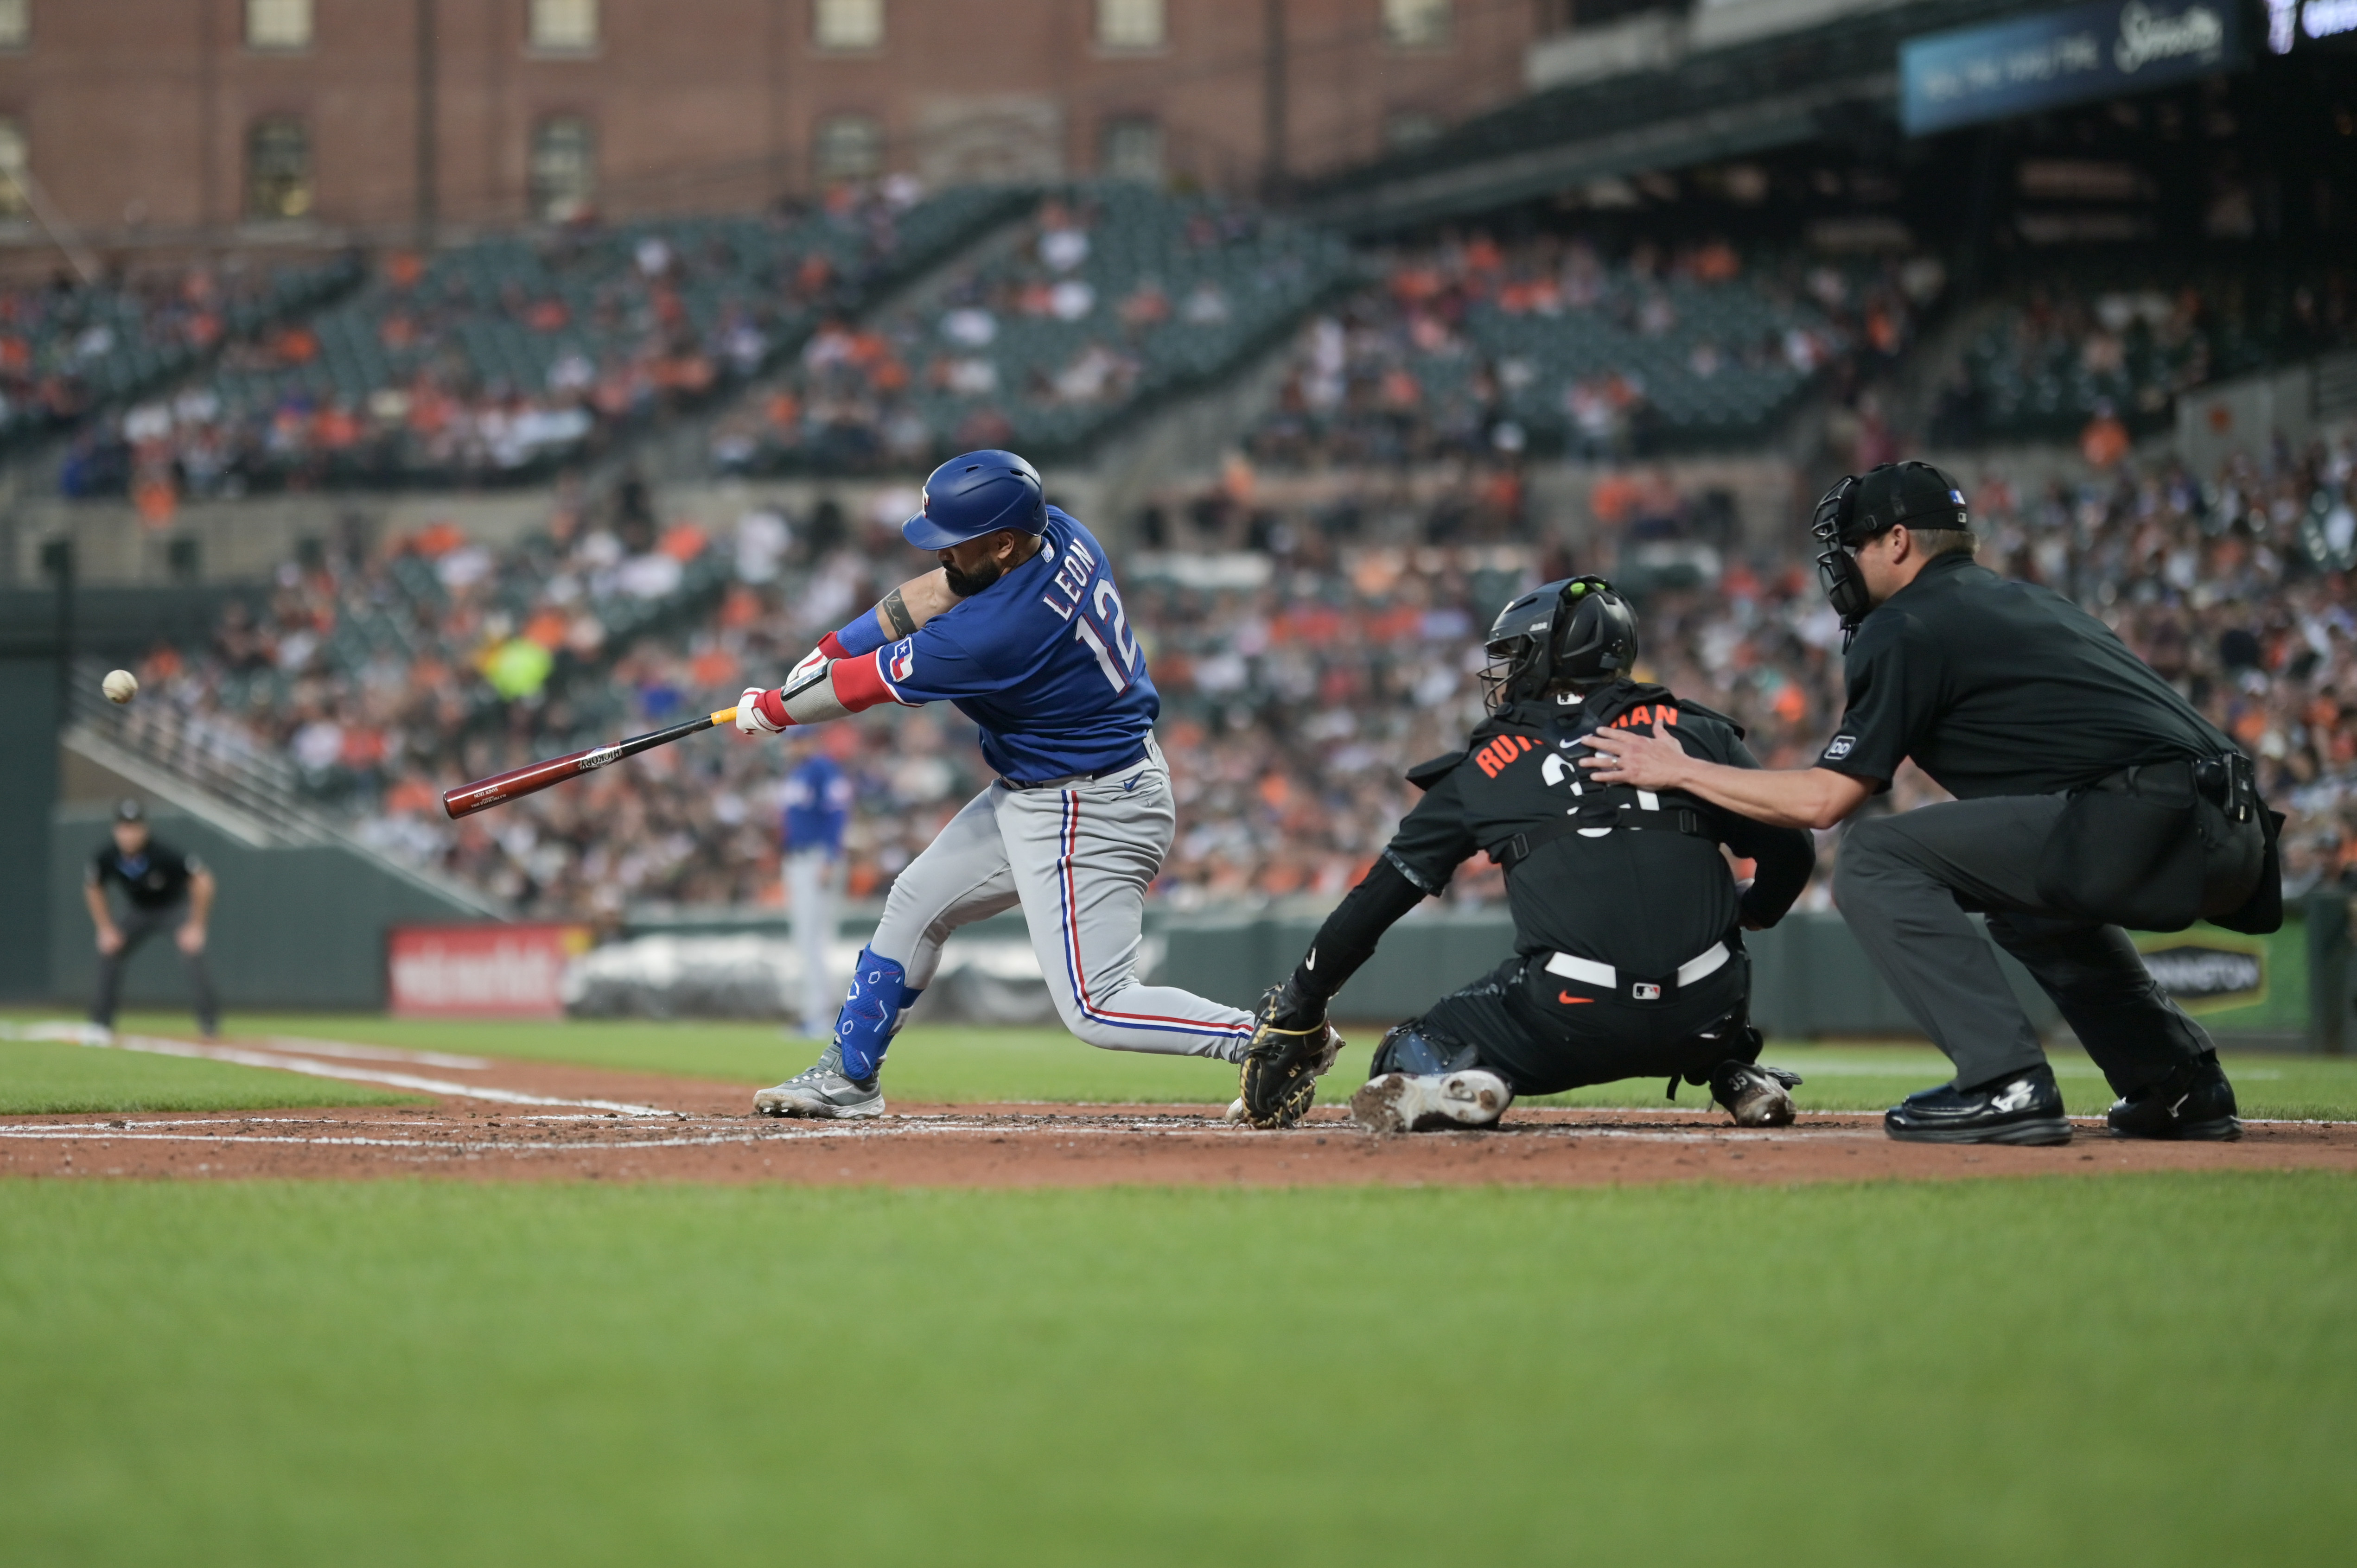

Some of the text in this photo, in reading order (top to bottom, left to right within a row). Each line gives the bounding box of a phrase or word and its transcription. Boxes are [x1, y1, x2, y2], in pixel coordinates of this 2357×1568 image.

[1043, 537, 1097, 623] LEON
[1073, 578, 1137, 697] 12
[581, 748, 621, 769] HICKORY
[485, 787, 498, 795] SANDY
[1727, 1072, 1748, 1091] 35
